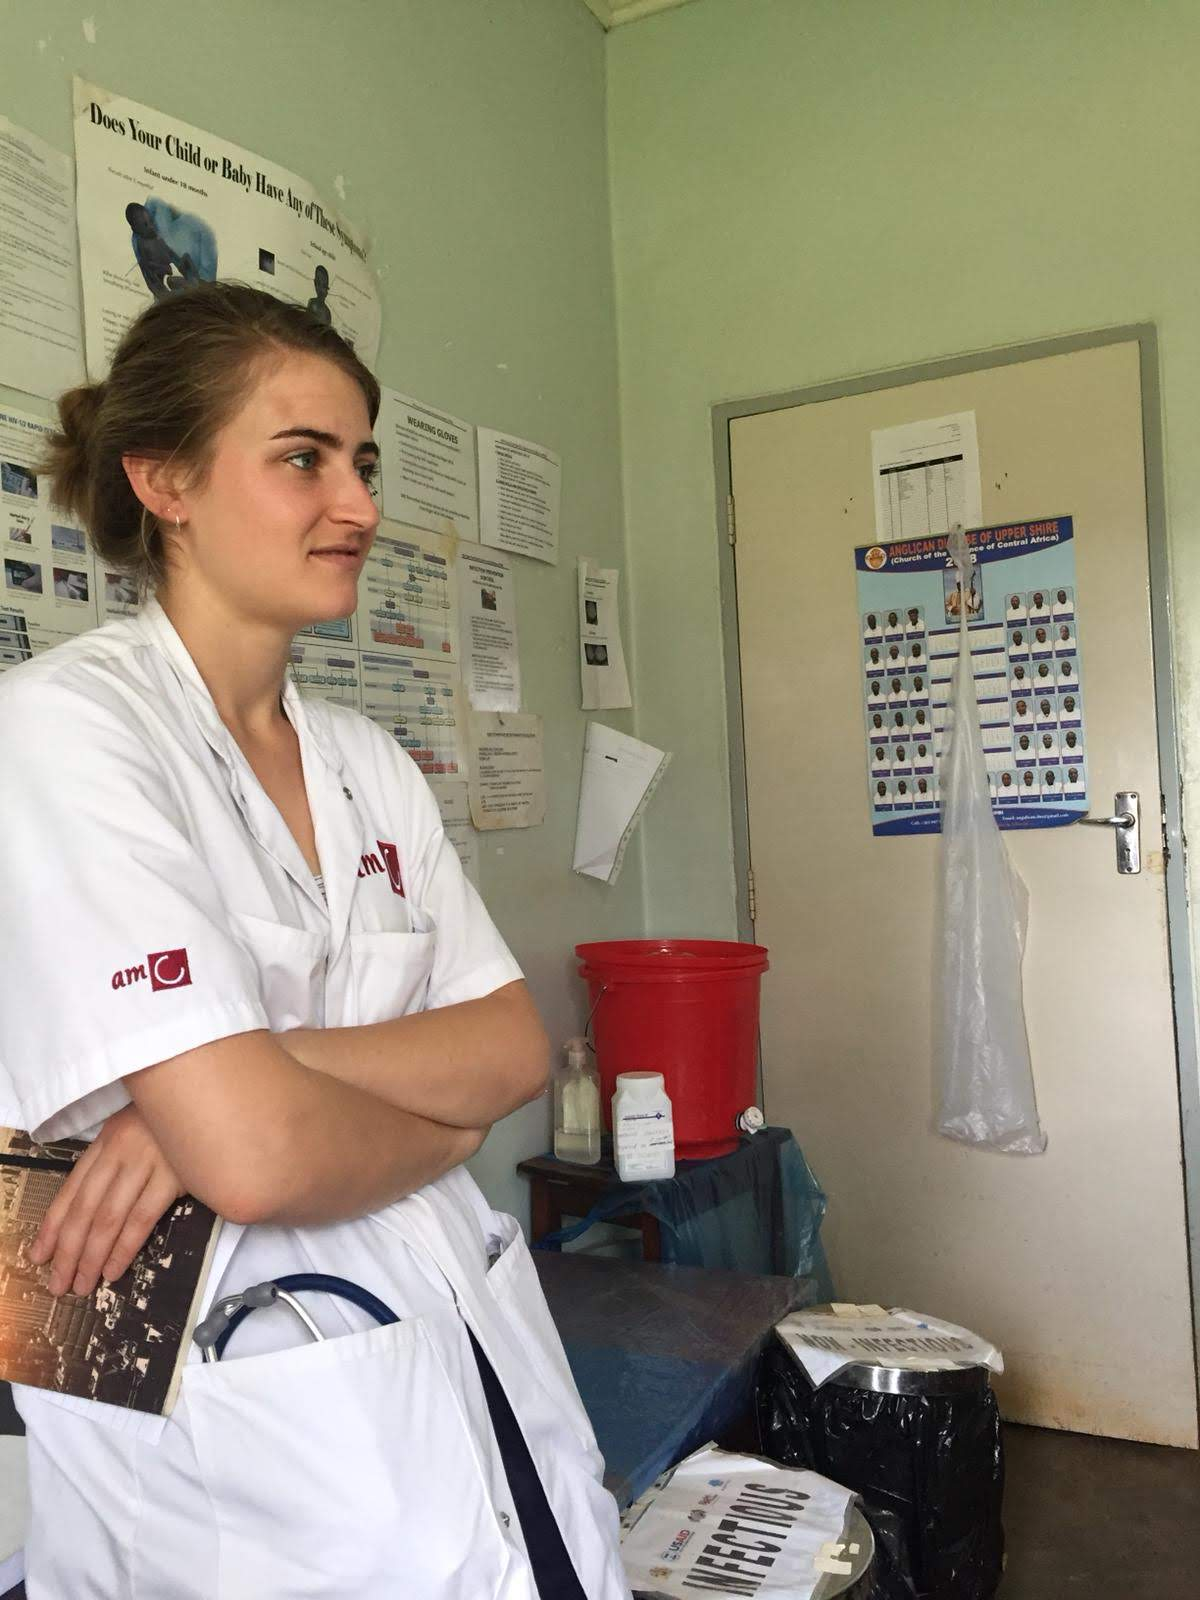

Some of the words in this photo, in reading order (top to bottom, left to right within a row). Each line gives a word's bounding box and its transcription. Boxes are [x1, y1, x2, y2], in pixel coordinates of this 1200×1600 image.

[90, 102, 126, 136] Does
[128, 117, 162, 151] Your
[165, 134, 201, 168] Child
[203, 156, 219, 174] or
[222, 157, 252, 193] Baby
[256, 171, 284, 203] Have
[286, 187, 305, 218] Any
[304, 202, 316, 220] of
[314, 203, 335, 237] These
[143, 166, 161, 179] Infant
[161, 174, 178, 186] under
[187, 184, 209, 198] months
[407, 415, 437, 437] WEARING
[437, 427, 459, 445] GLOVES
[889, 537, 935, 557] ANGLICAN
[980, 531, 992, 542] OF
[995, 526, 1026, 541] UPPER
[1029, 520, 1059, 536] SHIRE
[986, 543, 995, 551] of
[997, 538, 1028, 549] Central
[1030, 534, 1060, 545] Africa)
[891, 554, 922, 566] (Church
[923, 552, 932, 560] of
[795, 1333, 847, 1351] NON
[852, 1337, 974, 1352] INFECTIOUS
[668, 1529, 691, 1551] USAID
[682, 1483, 811, 1597] INFECTIOUS
